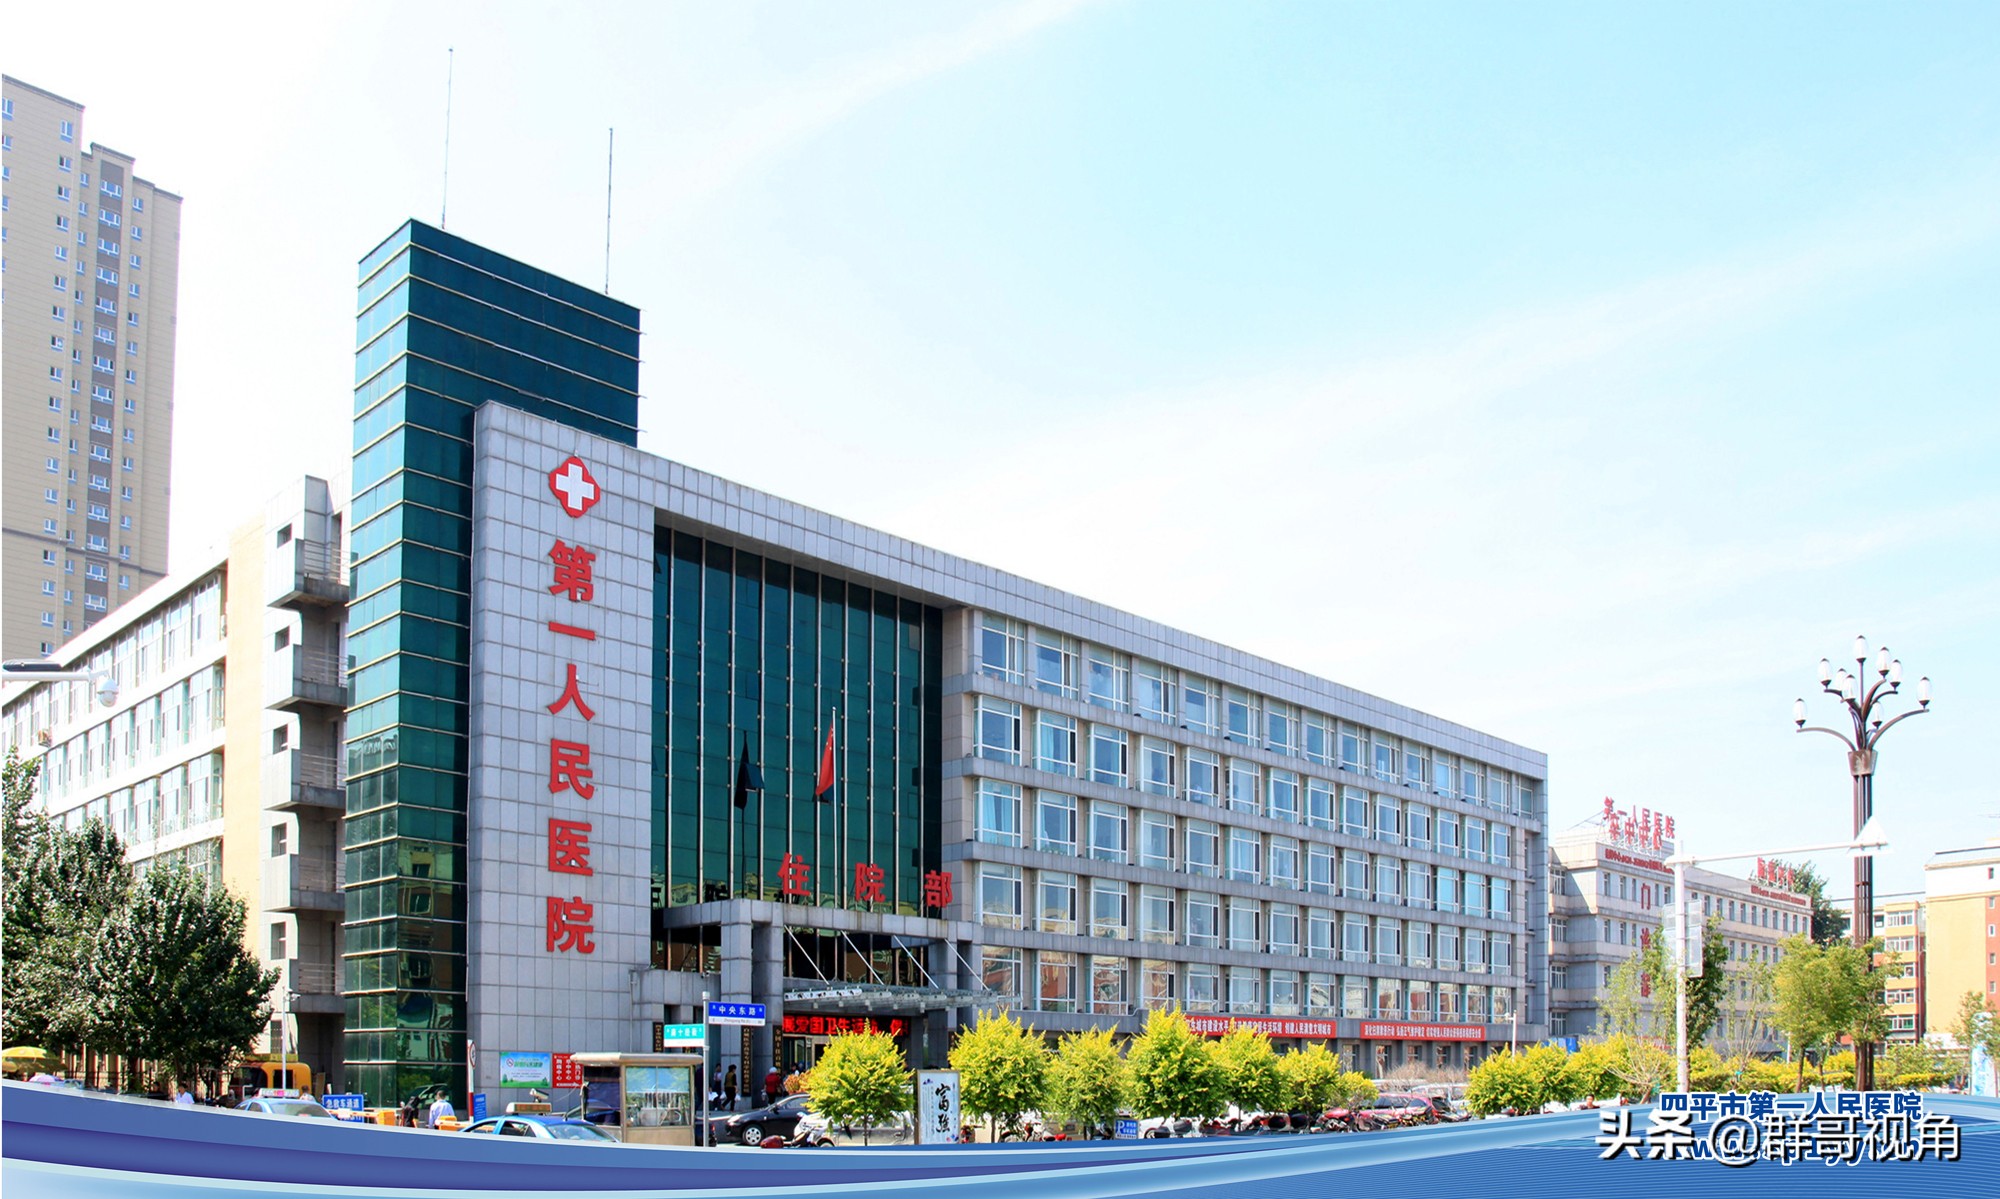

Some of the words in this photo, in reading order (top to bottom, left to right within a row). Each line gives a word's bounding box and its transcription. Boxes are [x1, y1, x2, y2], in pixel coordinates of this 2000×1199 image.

[546, 538, 597, 955] 第一人民医院
[1603, 796, 1675, 839] 第一人民医院
[777, 853, 953, 908] 住院部
[1641, 883, 1651, 998] 门诊部
[718, 1005, 756, 1016] 中央东路
